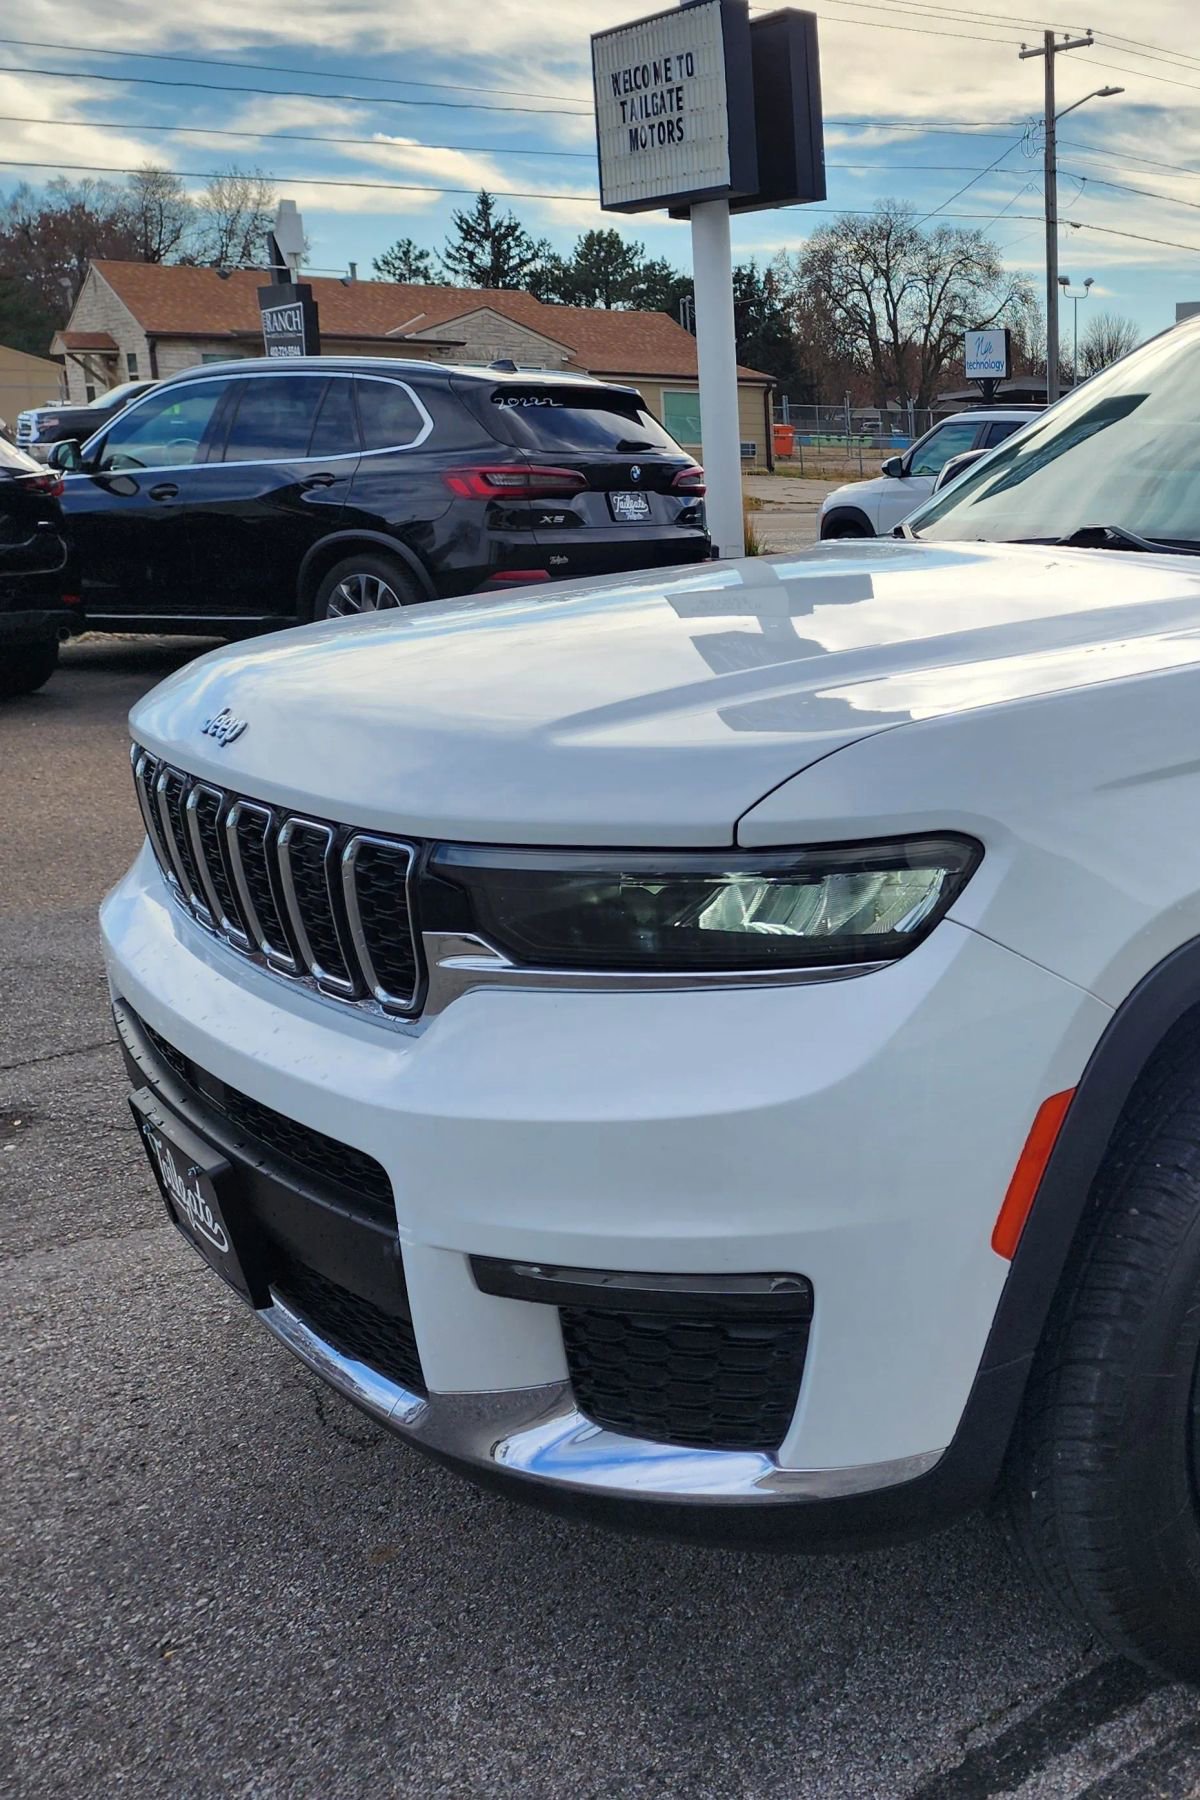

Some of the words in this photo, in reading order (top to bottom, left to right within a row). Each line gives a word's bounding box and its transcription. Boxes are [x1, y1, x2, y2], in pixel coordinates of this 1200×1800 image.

[611, 58, 671, 96] WELCOME
[677, 52, 694, 77] TO
[620, 86, 684, 123] TAILGATE
[629, 118, 684, 152] MOTORS
[265, 310, 302, 332] RANCH
[967, 360, 1004, 372] technology
[539, 515, 565, 523] X5
[201, 707, 248, 748] Jeep
